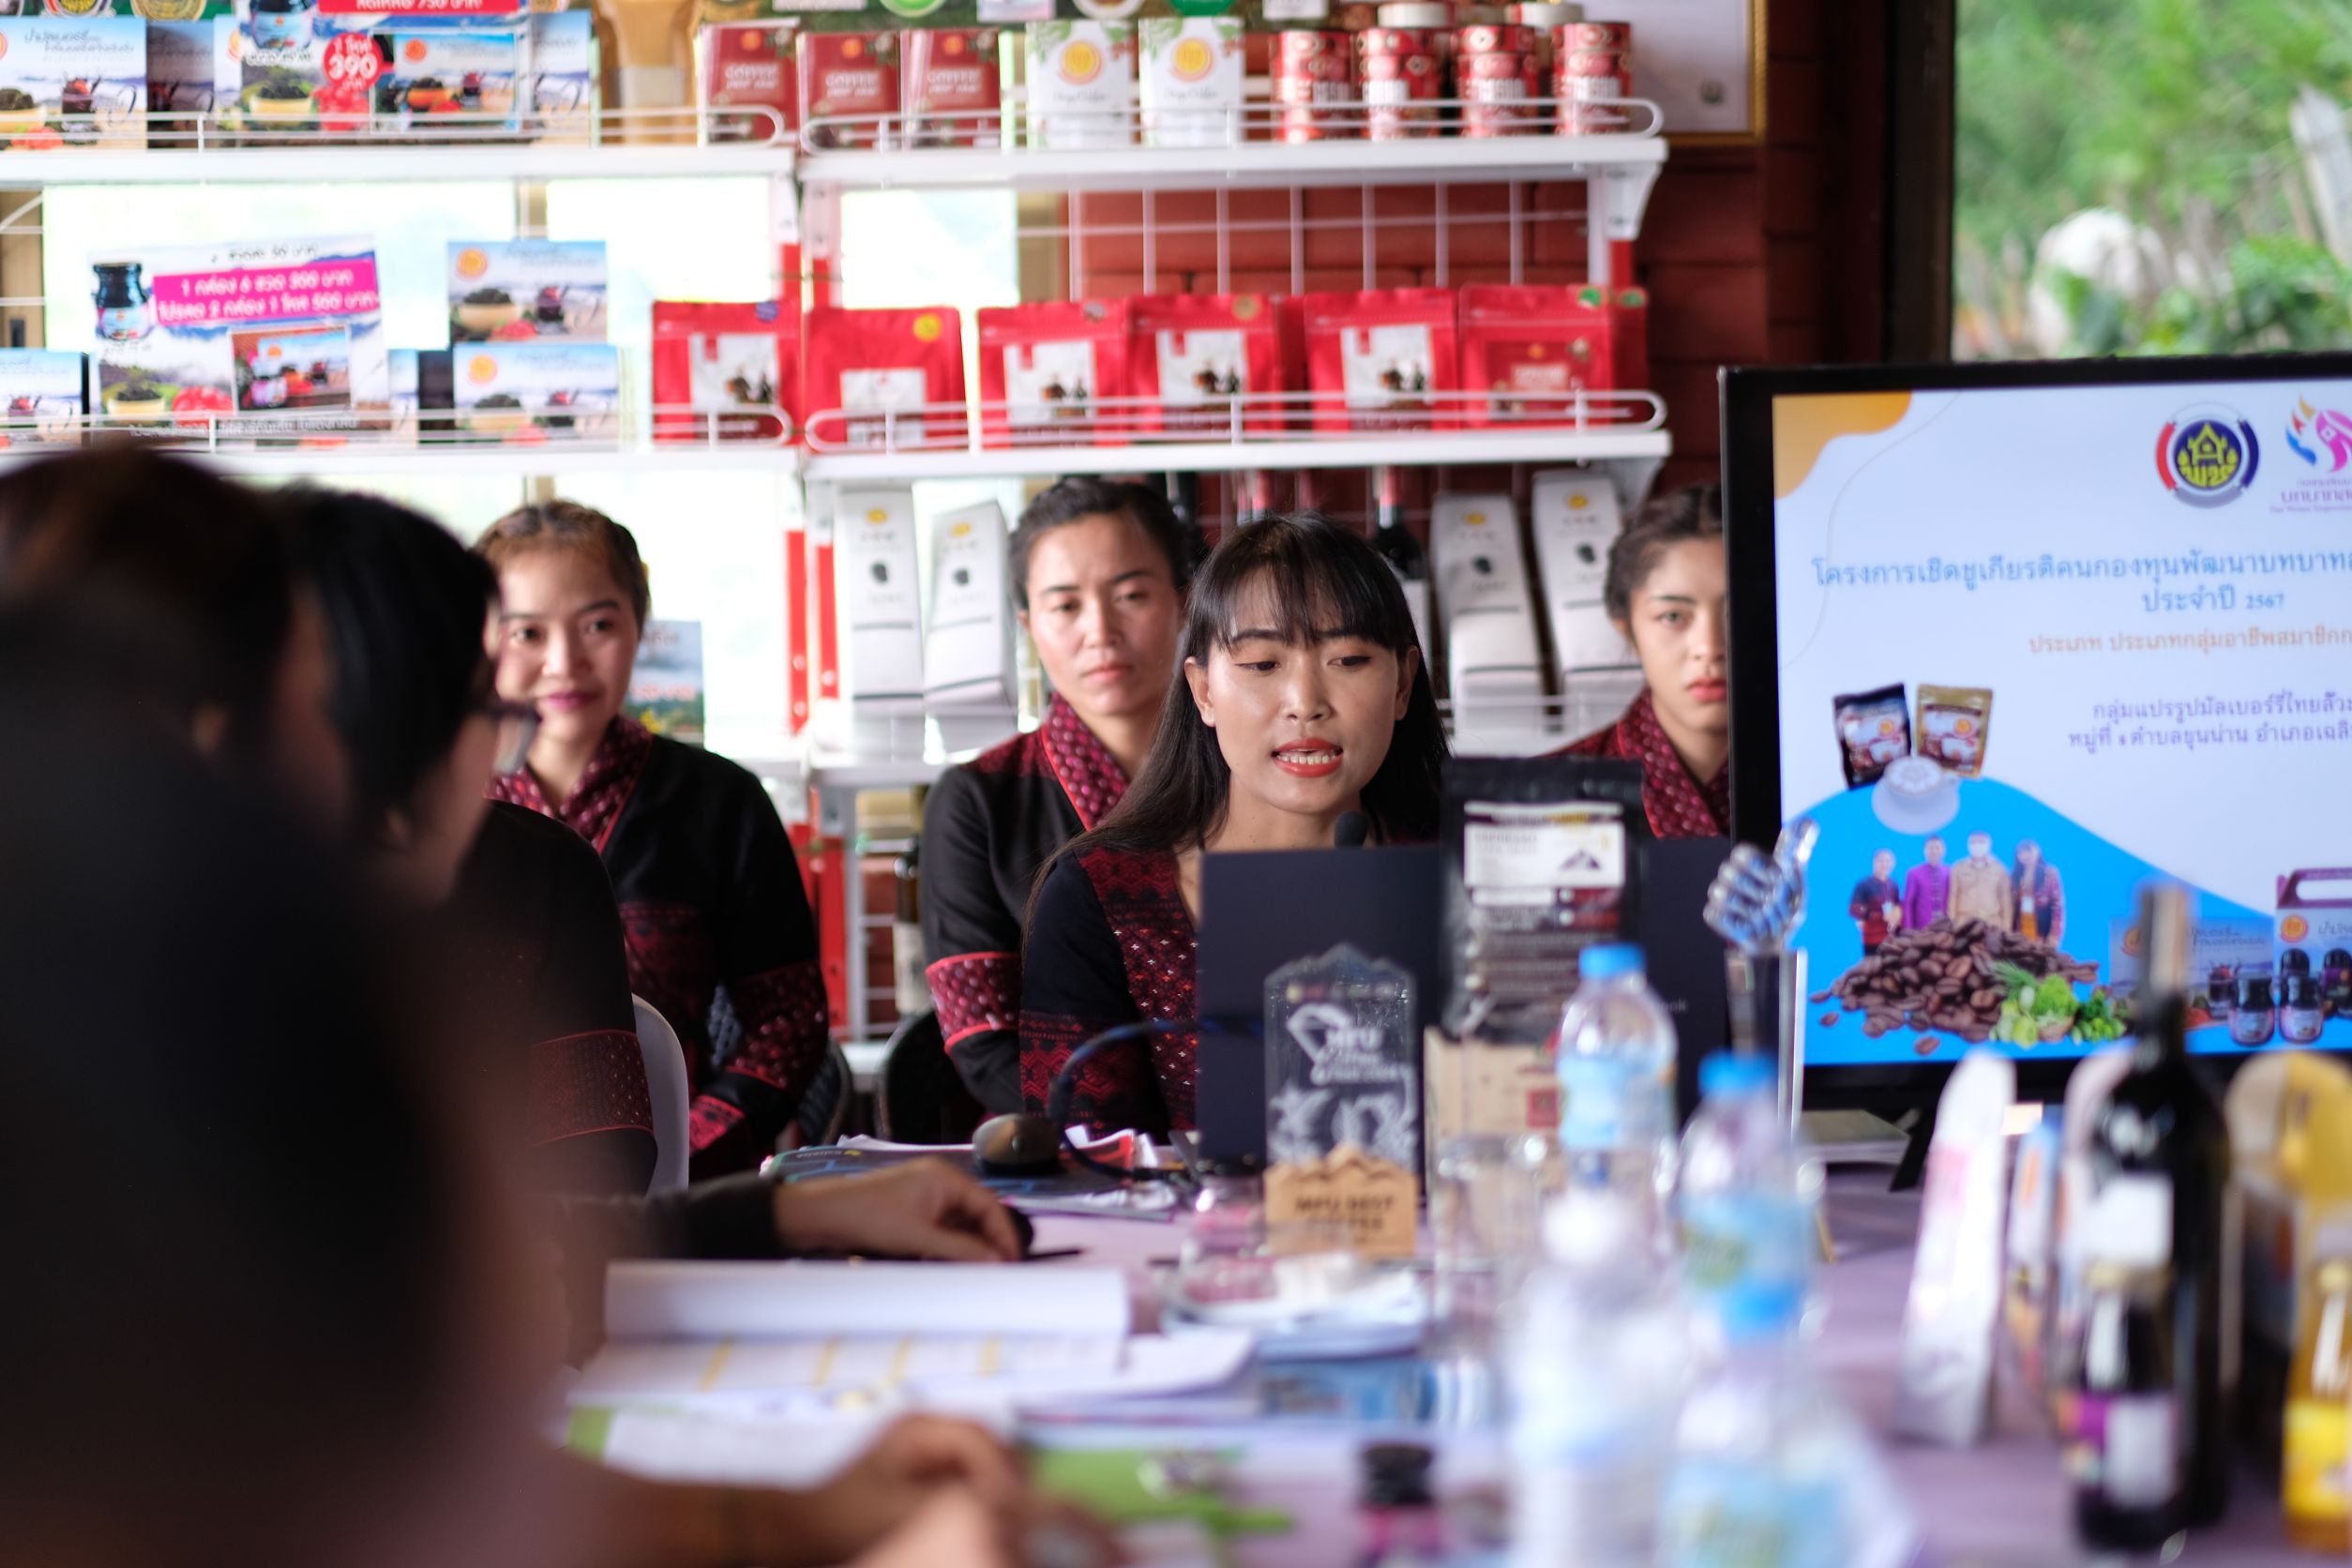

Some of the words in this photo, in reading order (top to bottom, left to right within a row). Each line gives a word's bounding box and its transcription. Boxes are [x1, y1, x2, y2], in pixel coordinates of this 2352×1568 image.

[328, 53, 379, 81] 390
[321, 269, 354, 288] บาท
[344, 290, 379, 309] บาท
[1811, 548, 2352, 592] โครงการเชิดชูเกียรติคนกองทุนพัฒนาบทบาท
[2141, 583, 2237, 612] ประจำปี
[2246, 593, 2285, 610] 2567
[2028, 634, 2103, 654] ประเภท
[2068, 722, 2111, 754] หมู่ที่
[2255, 720, 2352, 744] อำเภอเฉลิ
